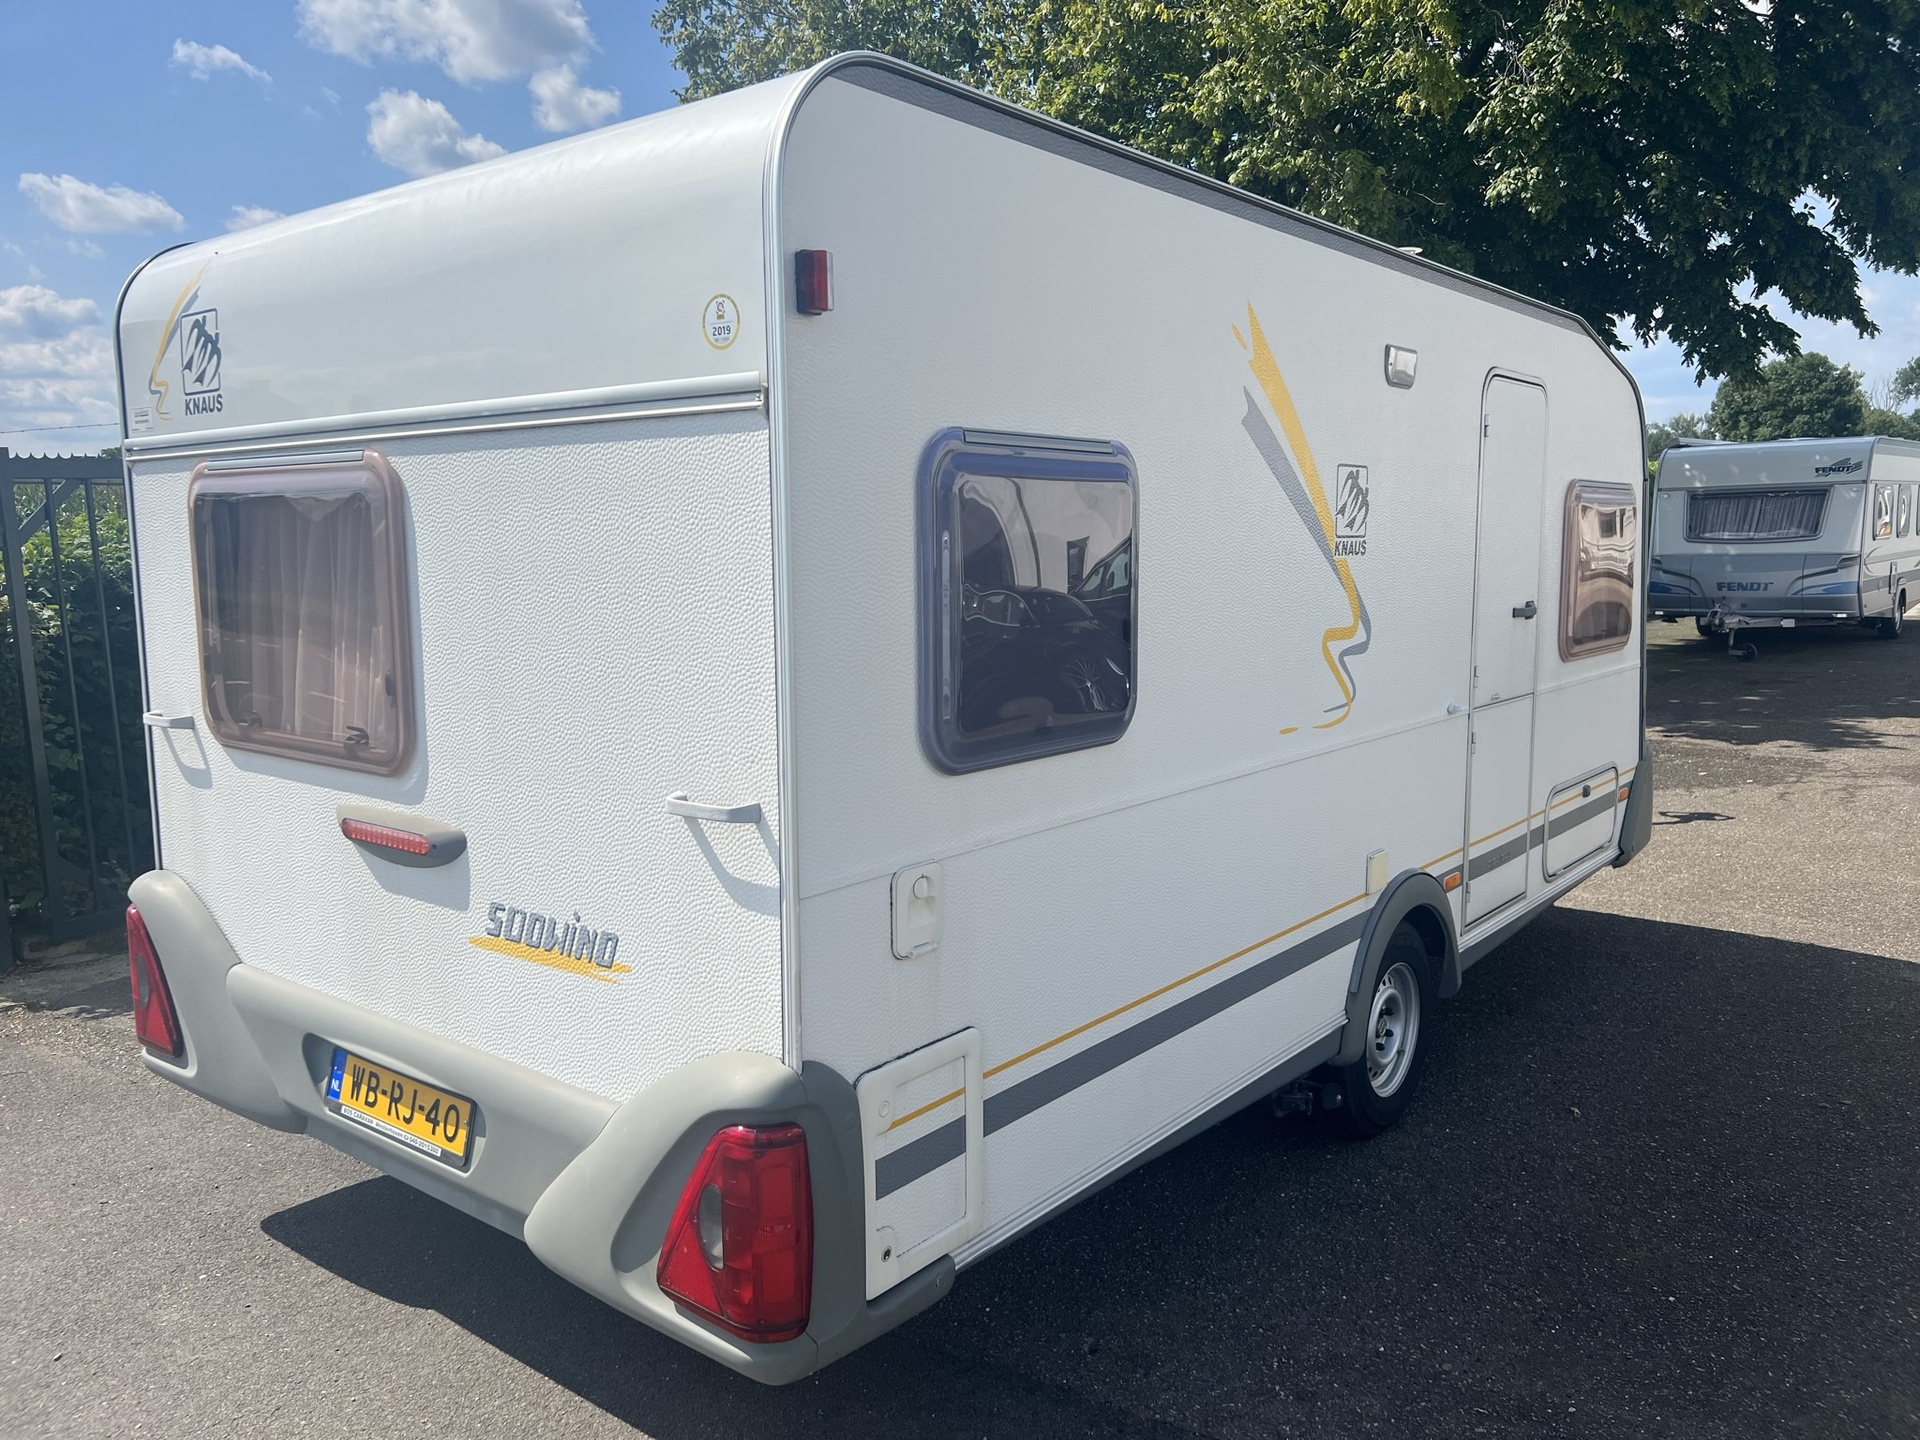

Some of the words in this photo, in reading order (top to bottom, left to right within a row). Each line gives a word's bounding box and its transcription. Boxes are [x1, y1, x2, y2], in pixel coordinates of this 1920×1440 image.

[712, 325, 731, 337] 2019
[185, 393, 223, 416] KNAUS
[1815, 465, 1853, 474] FENDT
[1334, 540, 1367, 556] KNAUS
[1716, 581, 1774, 592] FENDT
[331, 1078, 340, 1092] NL
[350, 1063, 460, 1143] WB-RJ-40
